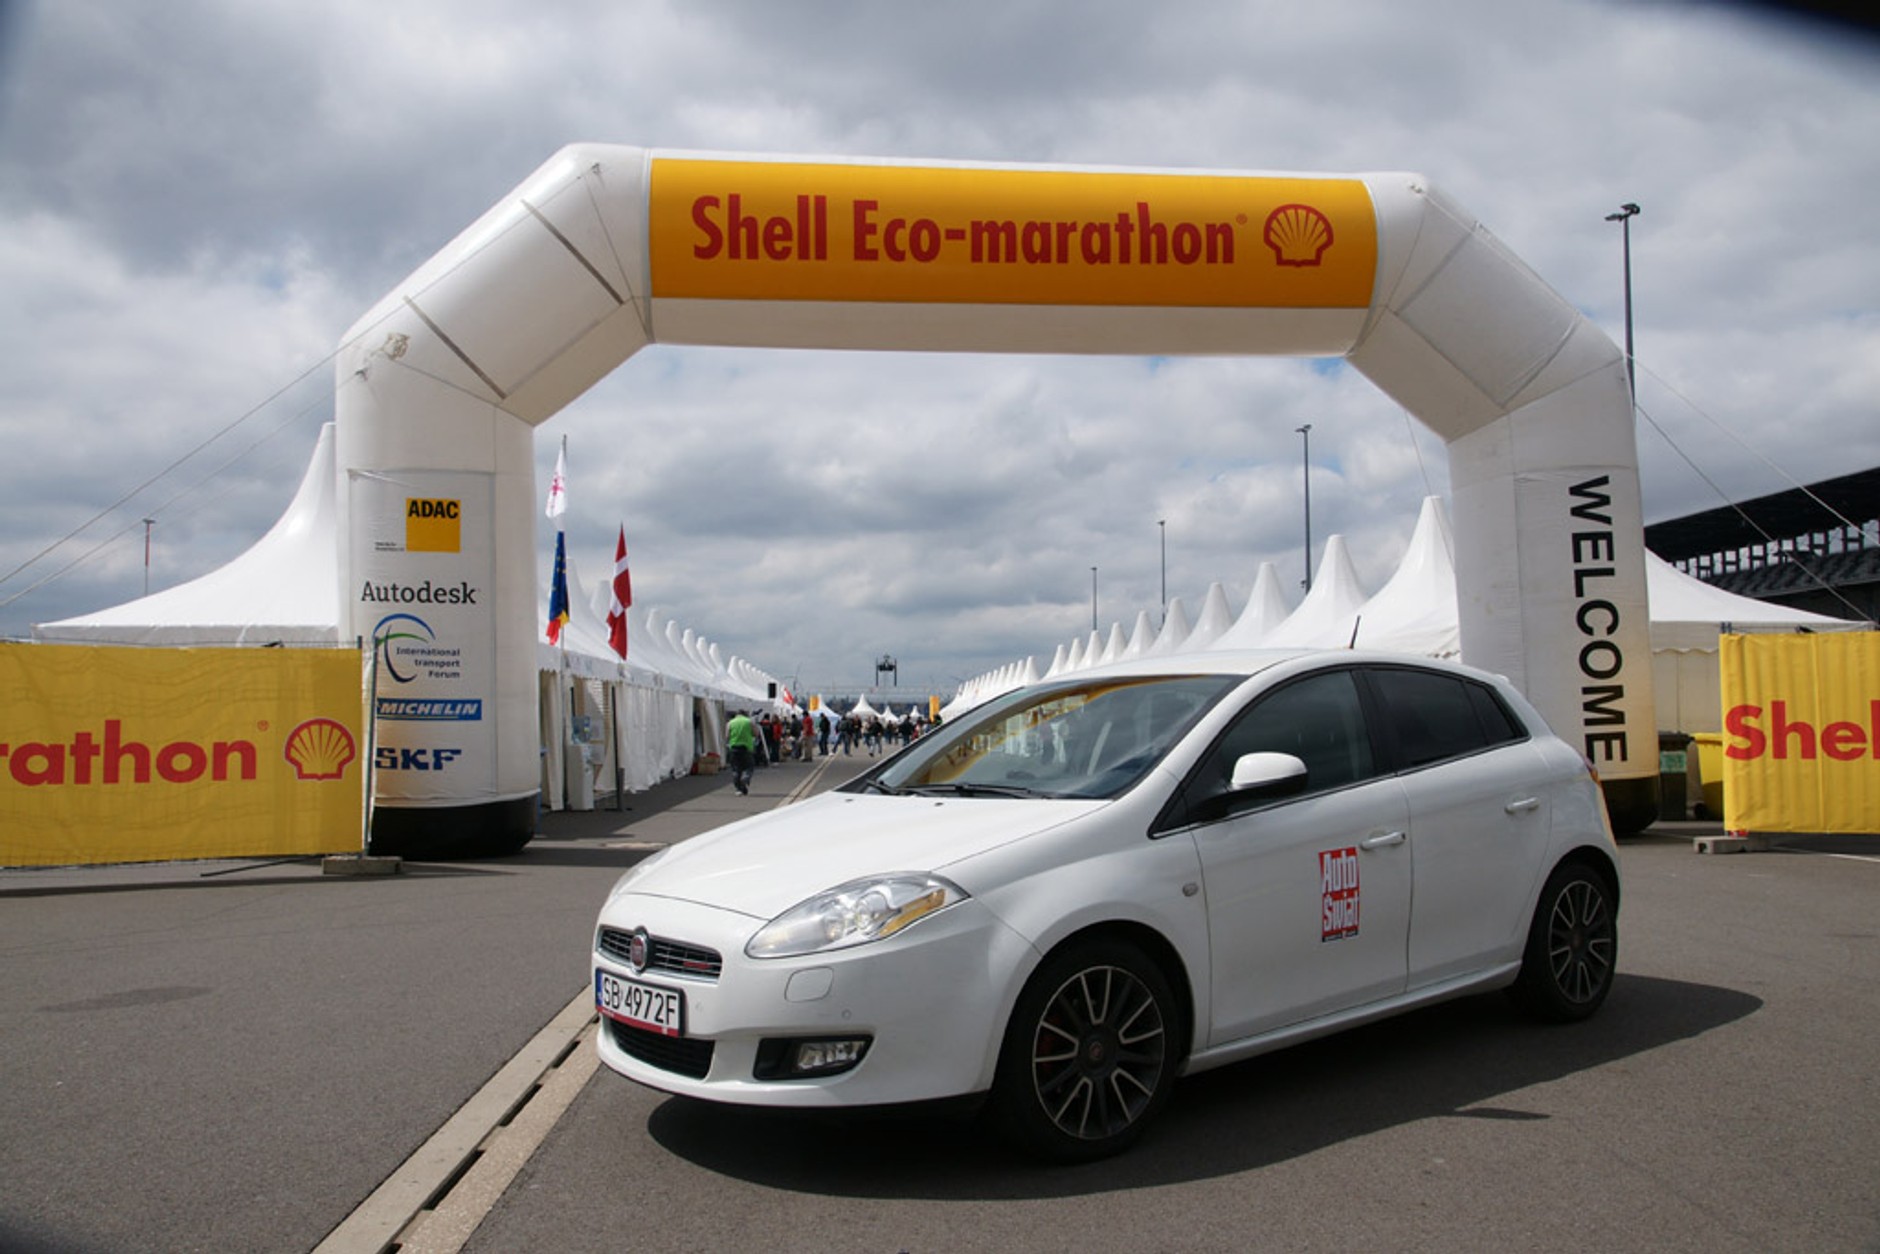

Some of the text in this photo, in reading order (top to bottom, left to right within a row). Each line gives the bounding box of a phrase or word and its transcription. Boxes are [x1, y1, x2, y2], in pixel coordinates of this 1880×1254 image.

[691, 193, 1235, 266] Shell Eco-marathon
[408, 500, 459, 519] ADAC
[361, 580, 477, 604] Autodesk
[1569, 475, 1627, 764] WELCOME
[396, 647, 460, 656] International
[414, 658, 460, 668] transport
[428, 670, 460, 679] Forum
[380, 702, 479, 715] MICHELIN
[375, 747, 462, 771] SKF
[1323, 849, 1358, 893] Auto
[603, 976, 678, 1025] SB 4972F
